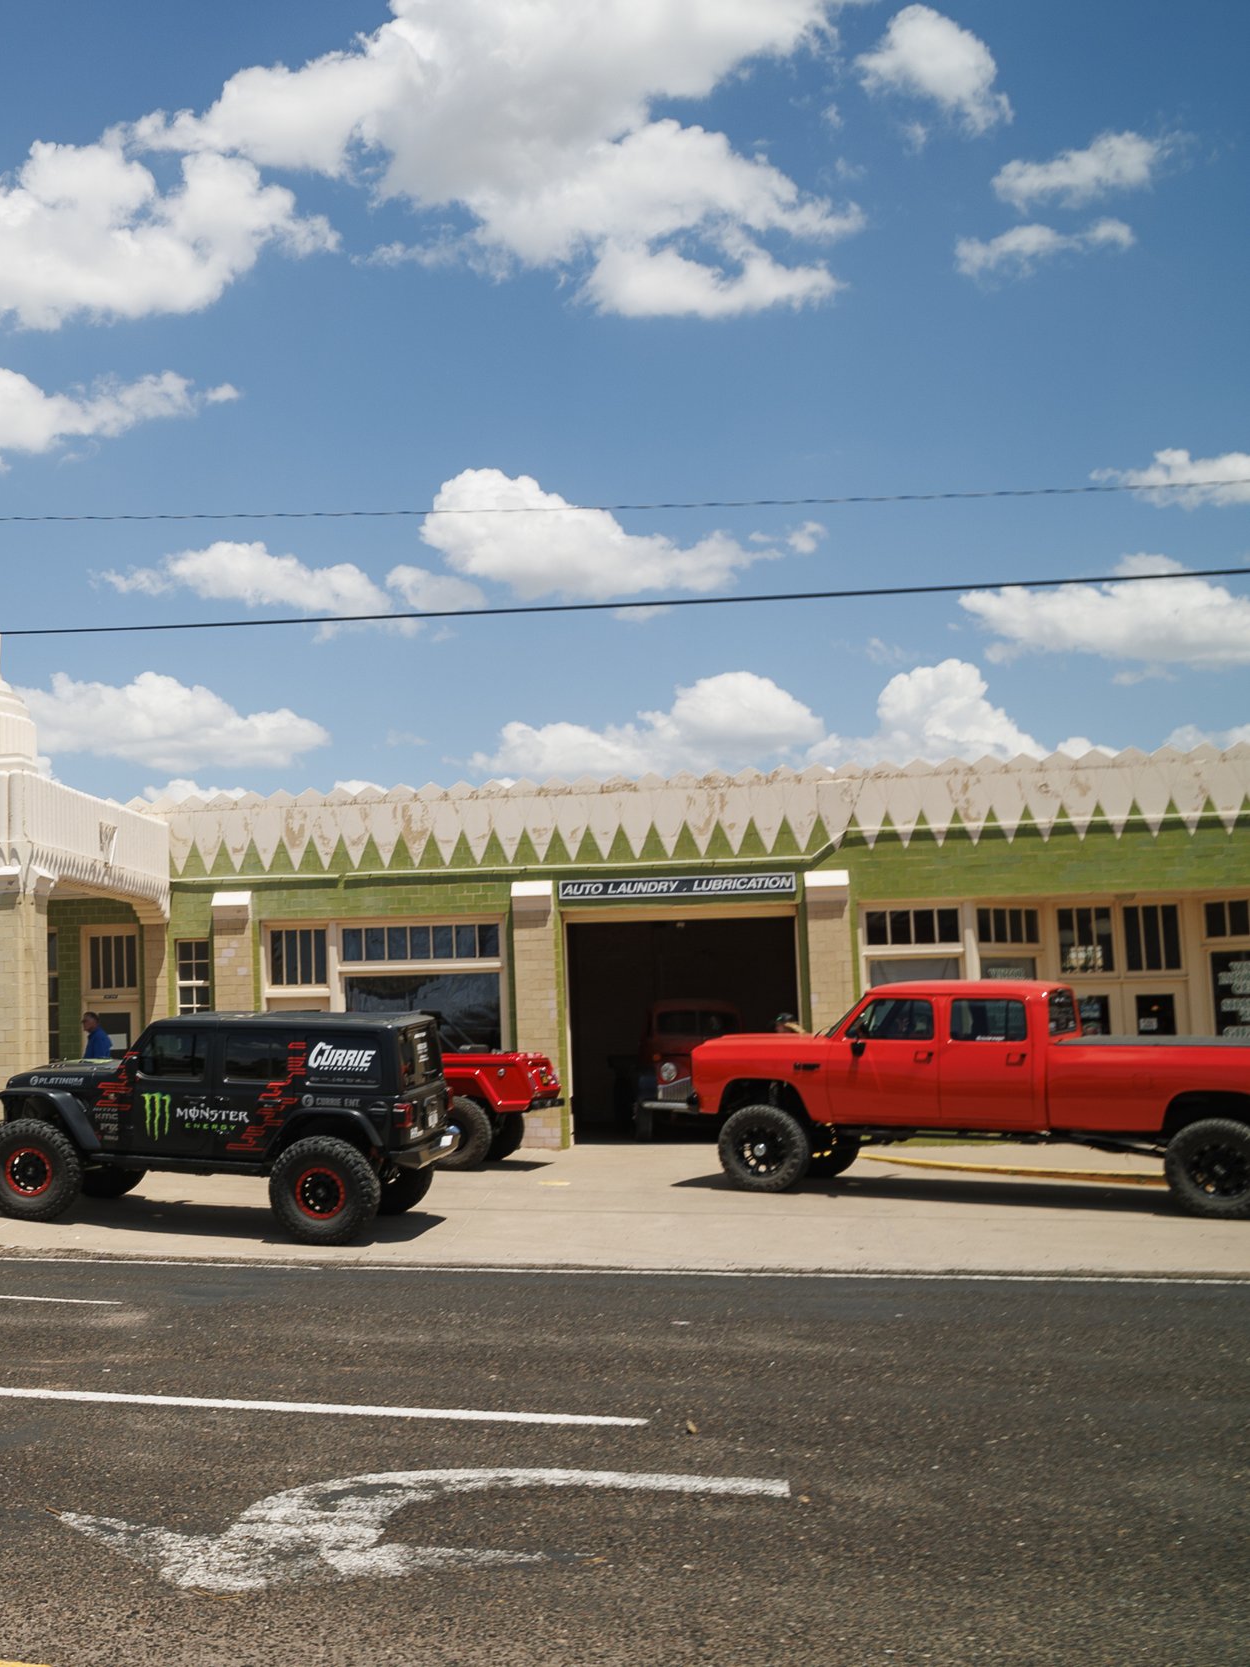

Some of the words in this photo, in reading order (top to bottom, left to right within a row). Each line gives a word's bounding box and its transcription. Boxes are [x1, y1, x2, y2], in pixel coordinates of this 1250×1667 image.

[562, 883, 603, 896] AUTO
[607, 880, 678, 895] LAUNDRY
[692, 876, 793, 892] LUBRICATION
[308, 1041, 377, 1069] CURRIE
[175, 1106, 250, 1124] MONSTER
[184, 1122, 237, 1130] ENERGY
